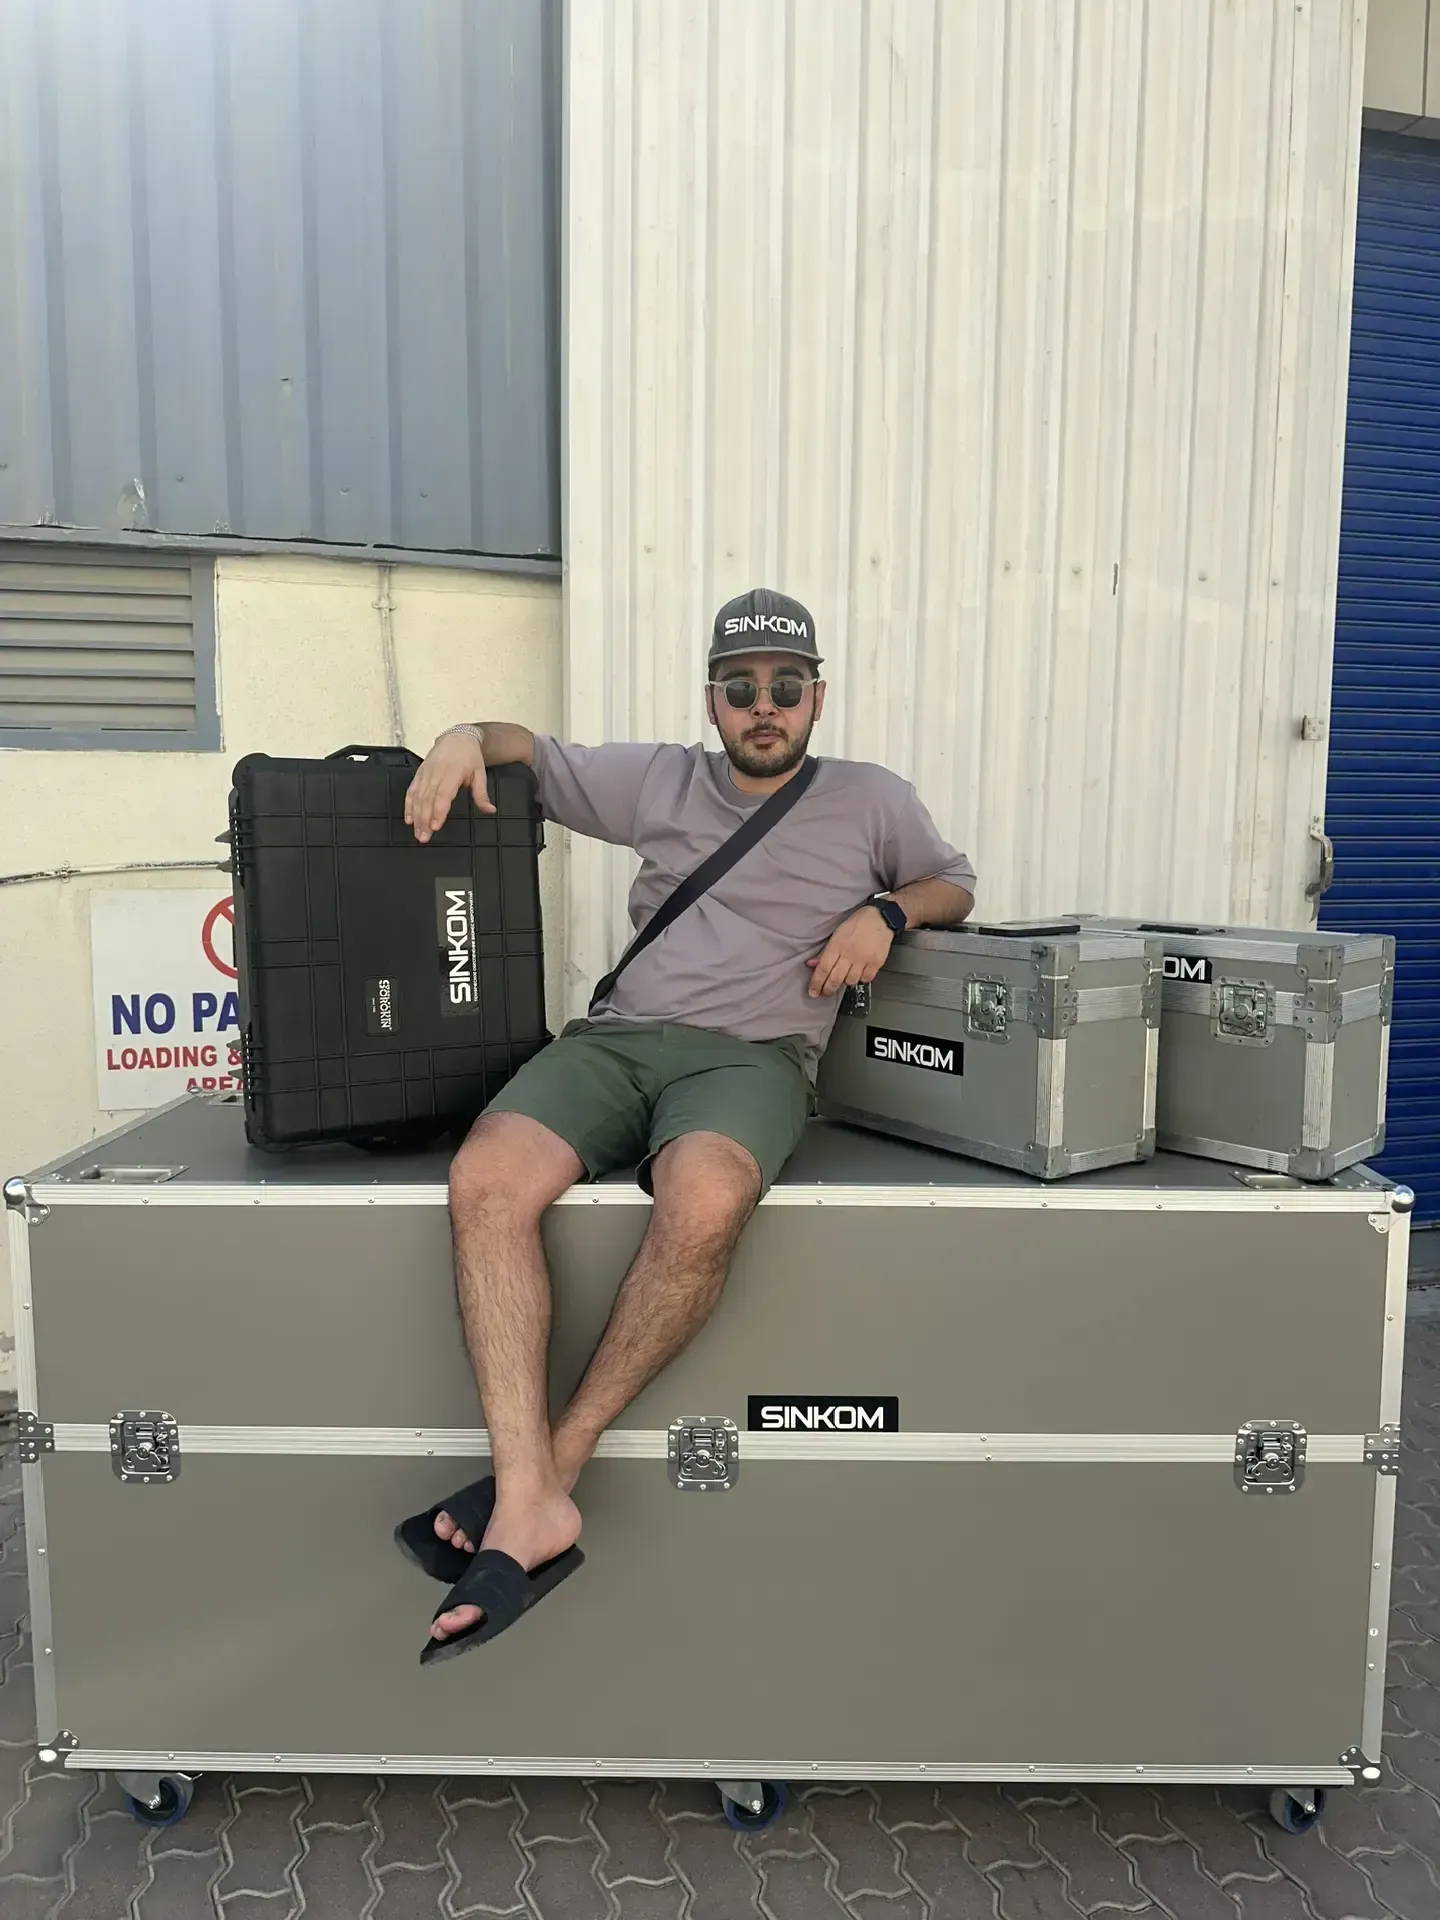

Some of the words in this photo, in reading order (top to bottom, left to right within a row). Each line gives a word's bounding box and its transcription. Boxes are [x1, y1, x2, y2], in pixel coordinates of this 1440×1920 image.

[724, 614, 808, 638] SINKOM
[445, 890, 472, 1004] SINKOM
[111, 993, 176, 1035] NO
[106, 1045, 217, 1070] LOADING
[227, 1048, 243, 1066] &
[873, 1036, 954, 1071] SINKOM
[186, 1076, 243, 1091] ARE
[760, 1405, 884, 1429] SINKOM
